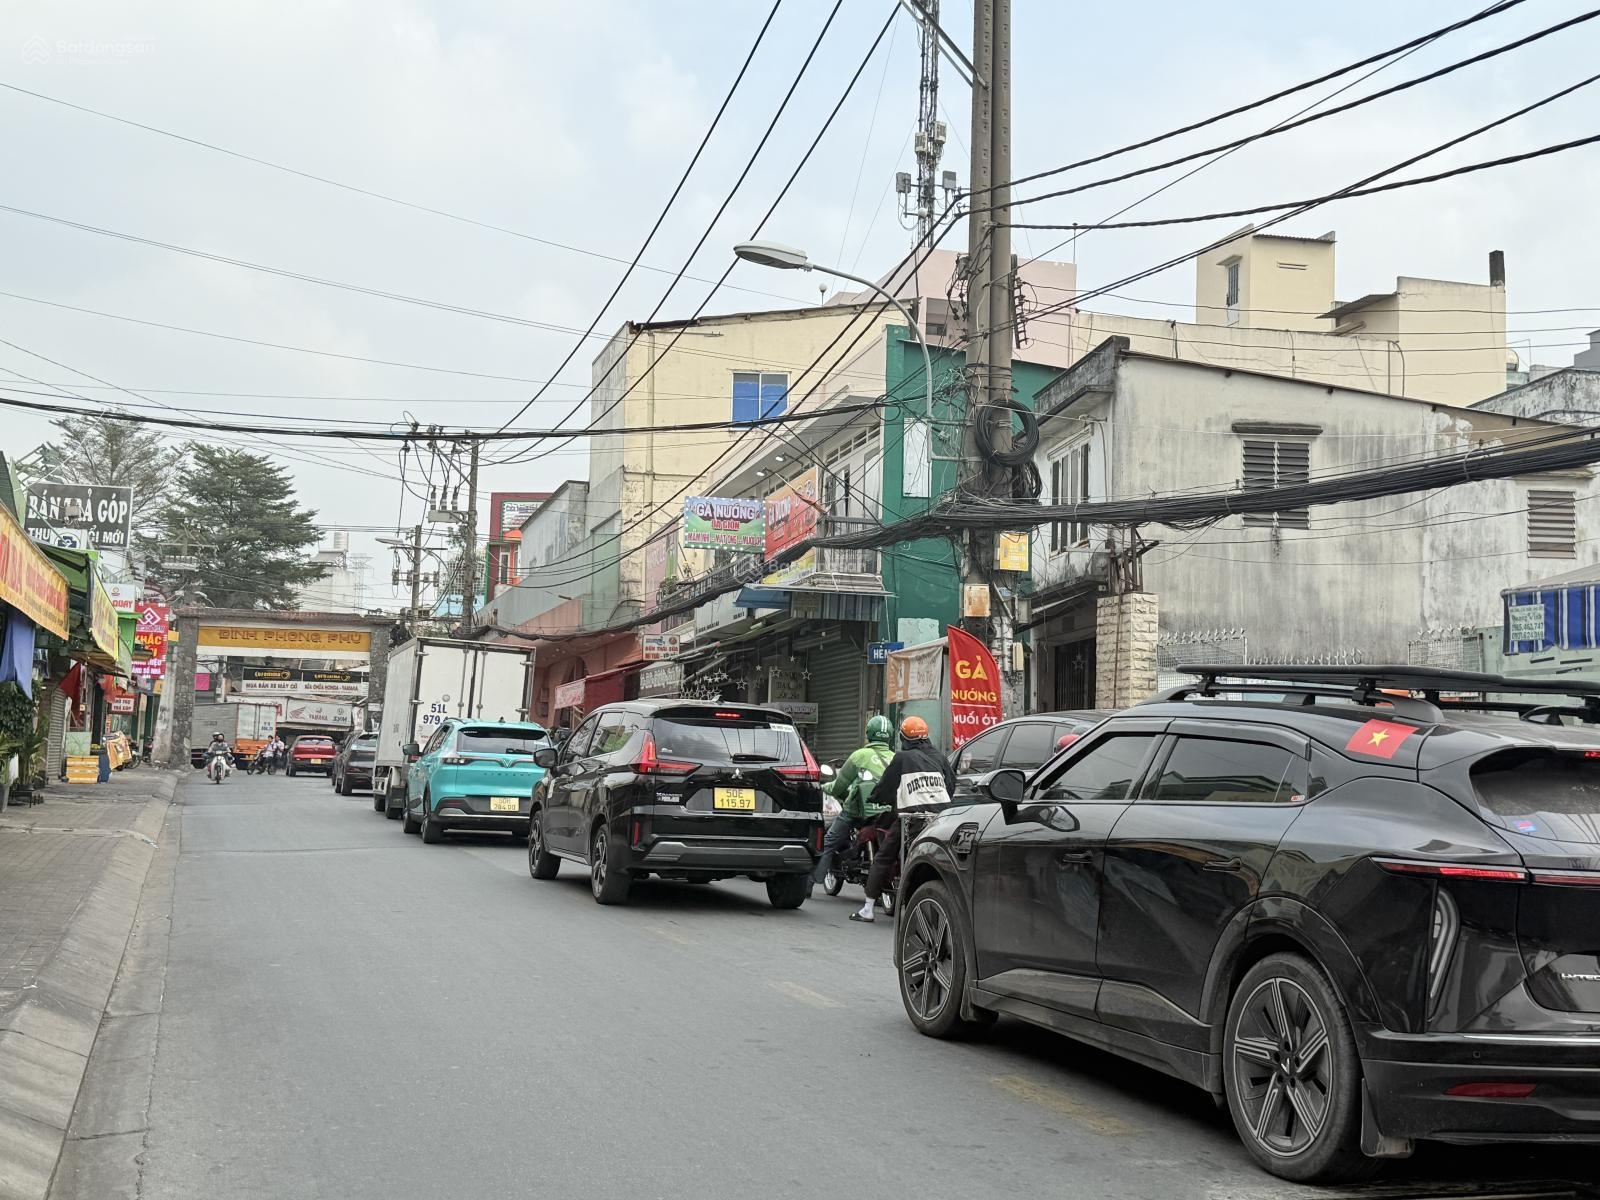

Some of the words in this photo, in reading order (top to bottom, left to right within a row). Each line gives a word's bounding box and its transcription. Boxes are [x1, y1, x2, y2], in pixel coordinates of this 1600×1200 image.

[28, 489, 61, 519] BÁN
[97, 493, 127, 524] GÓP
[697, 500, 714, 517] GÀ
[716, 503, 756, 520] NƯỚNG
[27, 527, 50, 542] THU
[102, 528, 125, 545] MỚI
[263, 630, 322, 643] PHONG
[955, 655, 988, 680] GÀ
[951, 688, 997, 703] NƯỚNG
[431, 703, 447, 713] 51L
[981, 711, 998, 726] ỚT
[726, 788, 743, 799] 50E
[719, 798, 751, 809] 115.97
